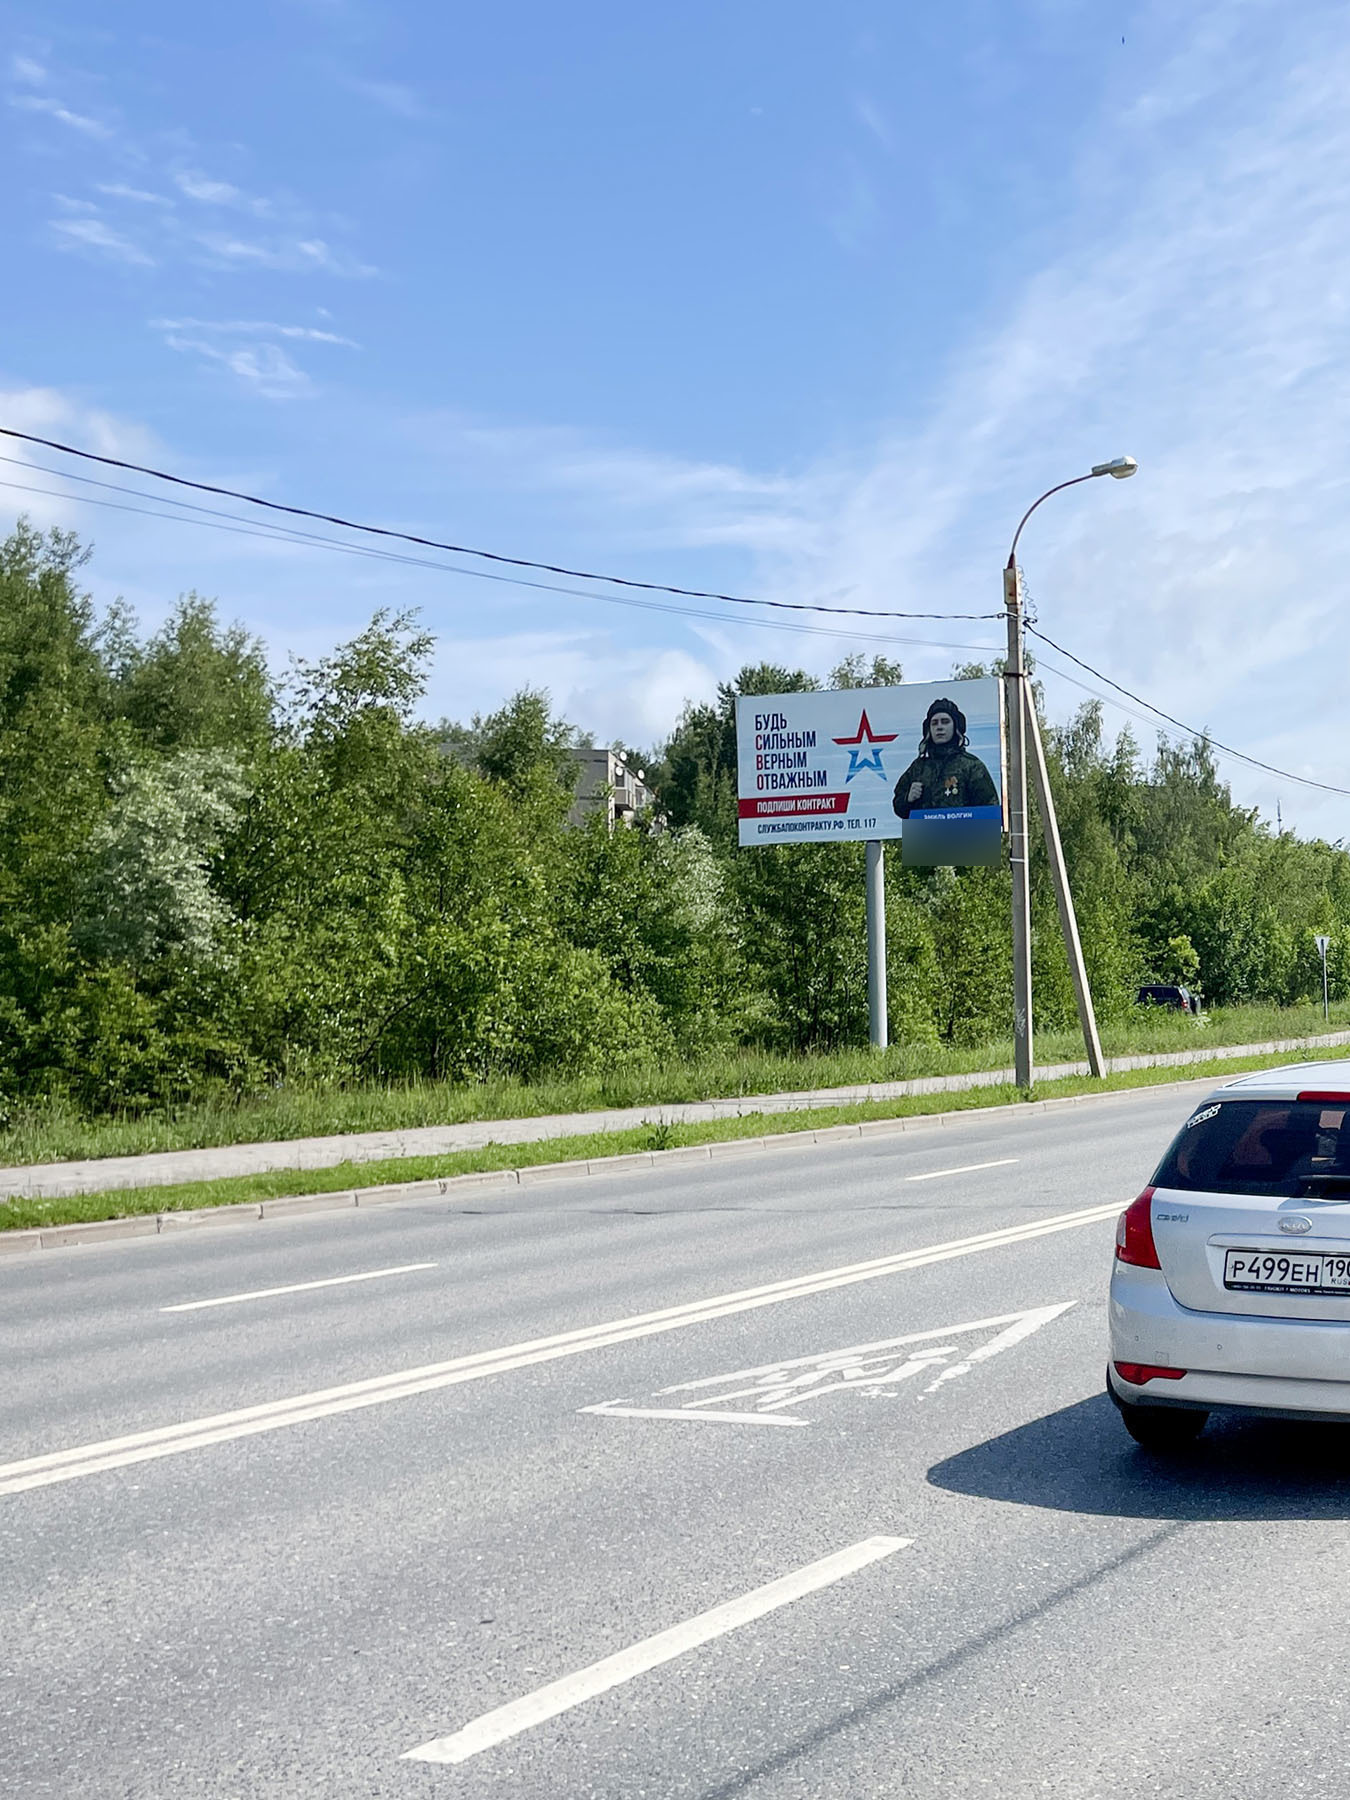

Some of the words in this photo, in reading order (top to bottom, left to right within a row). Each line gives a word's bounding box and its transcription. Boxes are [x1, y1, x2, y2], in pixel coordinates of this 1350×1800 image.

[755, 713, 787, 732] БУДЬ
[755, 731, 816, 750] СИЛЬНЫМ
[756, 751, 807, 770] ВЕРНЫМ
[757, 770, 827, 790] ОТВАЖНЫМ
[757, 799, 795, 814] ПОДПИШИ
[797, 797, 836, 812] КОНТРАКТ
[864, 818, 876, 828] 117
[1331, 1277, 1348, 1286] RUS
